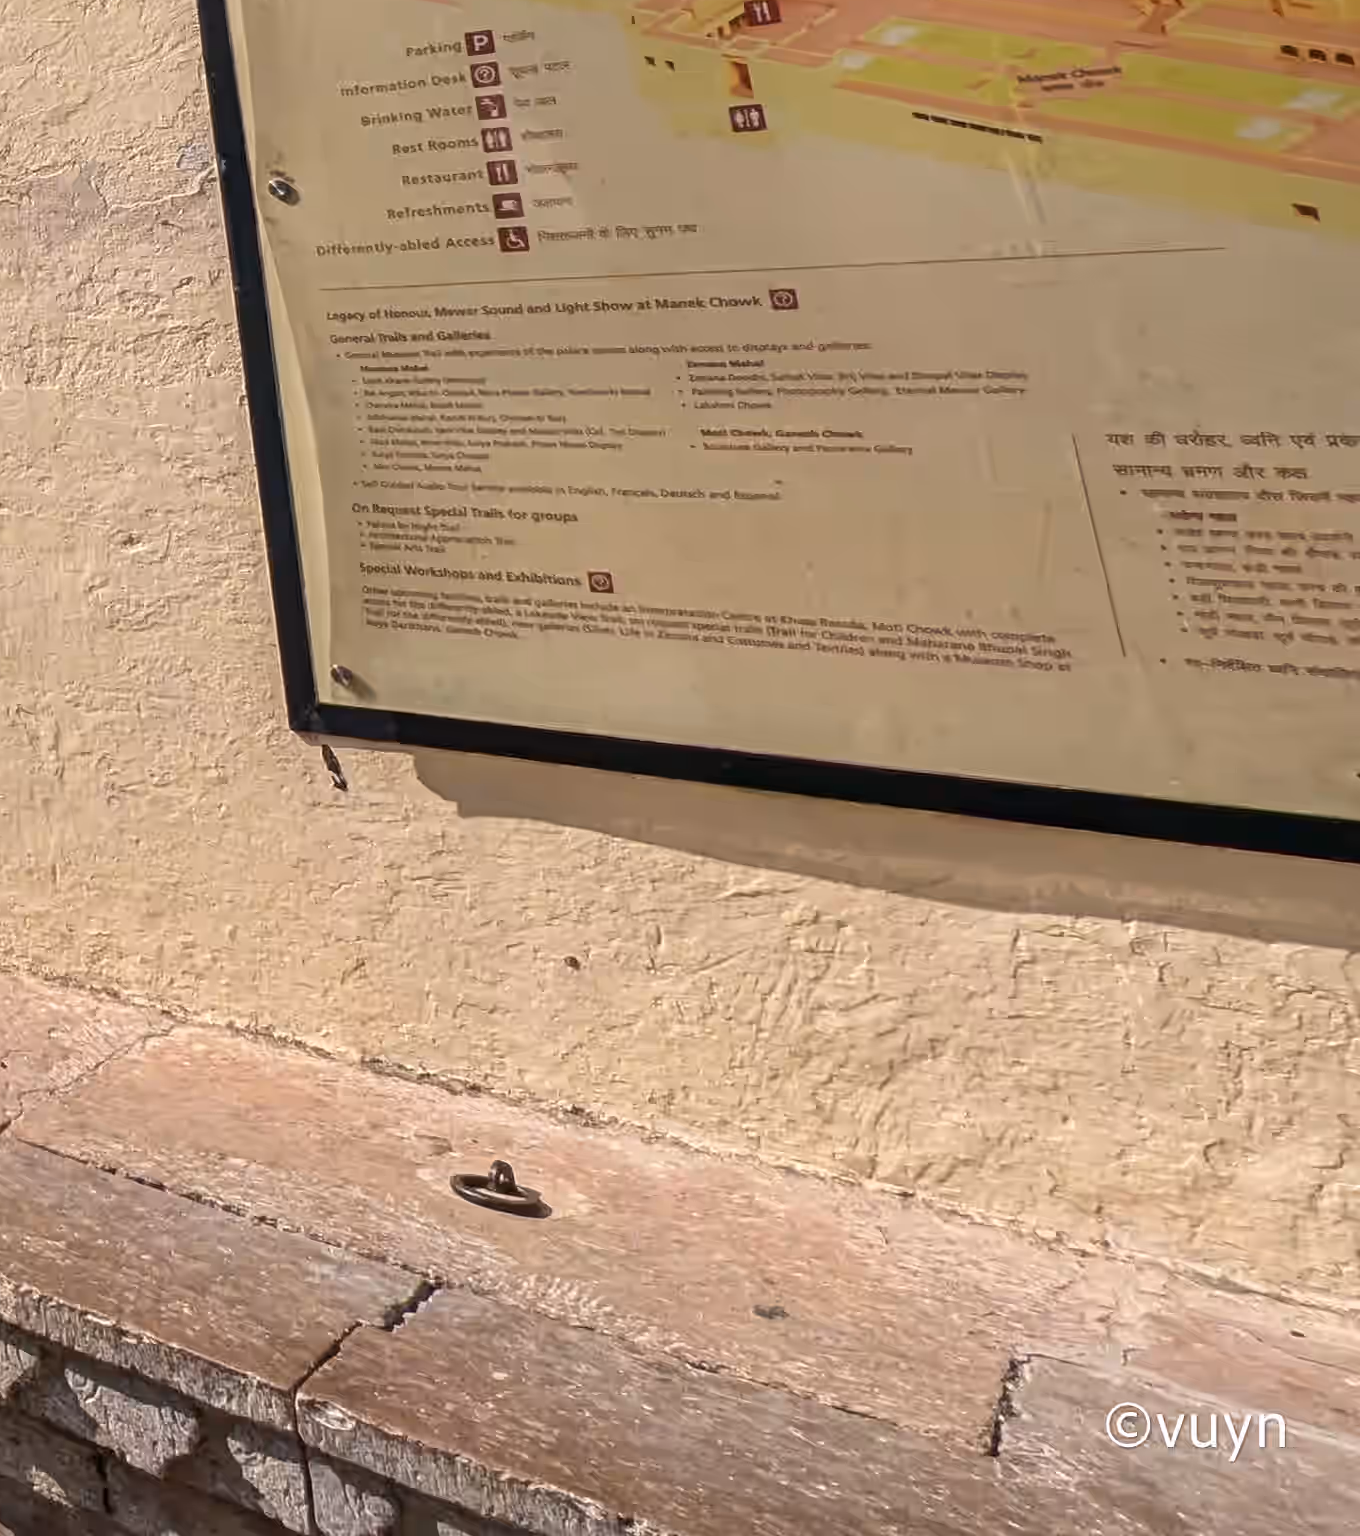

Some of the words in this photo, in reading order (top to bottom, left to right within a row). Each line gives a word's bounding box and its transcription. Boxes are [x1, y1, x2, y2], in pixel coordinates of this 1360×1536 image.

[405, 41, 463, 57] Parking
[340, 79, 427, 97] Information
[431, 72, 467, 86] Desk
[361, 112, 422, 127] Drinking
[426, 105, 472, 119] Water
[392, 142, 423, 155] Rest
[428, 137, 479, 151] Rooms
[401, 169, 484, 185] Restaurant
[386, 202, 490, 220] Refreshments
[445, 235, 495, 249] Access
[327, 311, 365, 322] Legacy
[369, 310, 381, 320] of
[482, 303, 522, 316] Sound
[527, 303, 551, 314] and
[555, 303, 589, 315] Light
[593, 300, 633, 312] Show
[637, 300, 652, 311] at
[655, 297, 706, 309] Manek
[709, 295, 763, 308] Chowk
[329, 332, 374, 345] General
[377, 331, 408, 343] Trails
[411, 330, 433, 342] and
[437, 328, 491, 341] Galleries
[352, 502, 368, 514] On
[371, 503, 421, 517] Request
[424, 505, 468, 519] Special
[471, 506, 504, 519] Trails
[508, 509, 529, 521] for
[531, 511, 579, 525] groups
[359, 562, 400, 576] Special
[403, 564, 474, 582] Workshops
[479, 570, 502, 582] and
[506, 571, 582, 587] Exhibitions
